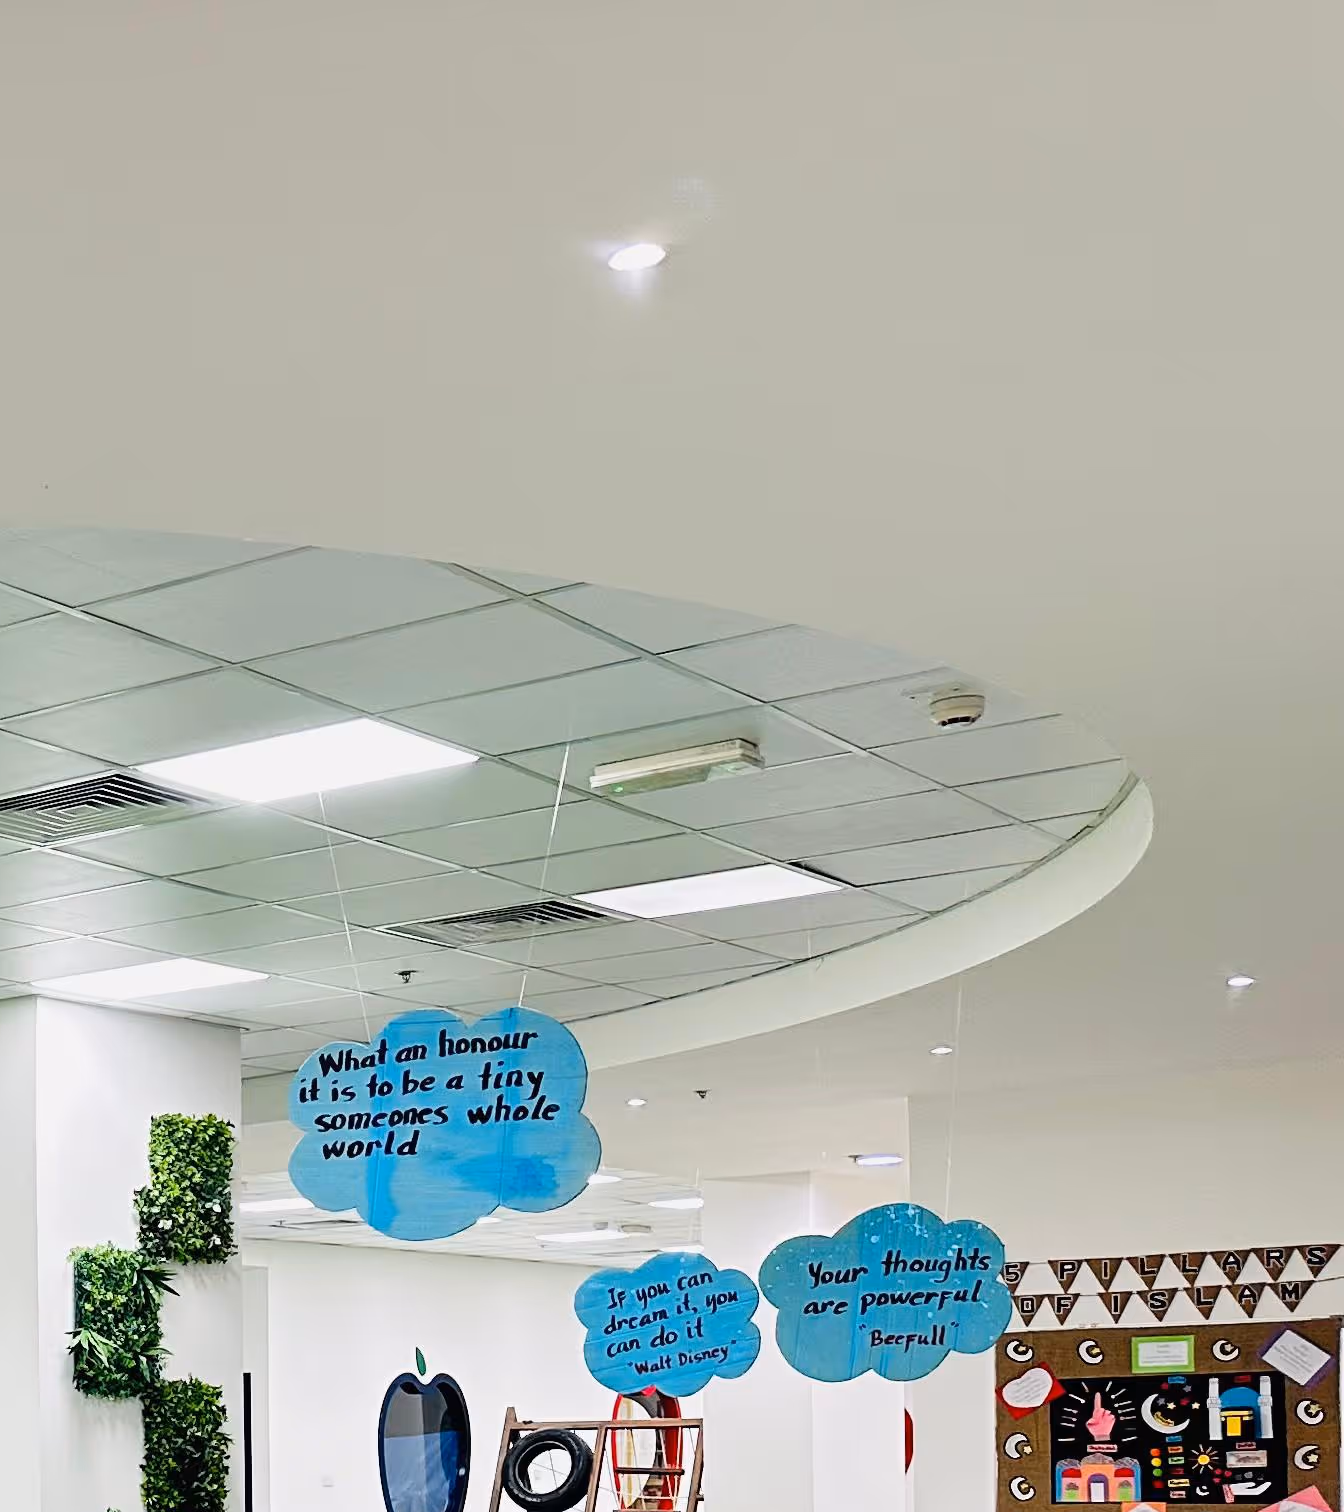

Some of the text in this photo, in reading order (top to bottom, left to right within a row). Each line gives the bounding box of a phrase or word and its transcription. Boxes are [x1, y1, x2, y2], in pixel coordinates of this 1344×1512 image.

[318, 1028, 538, 1078] What an honour
[299, 1061, 545, 1103] it is to be a tiny
[314, 1093, 561, 1133] someones whole
[322, 1130, 420, 1160] world
[808, 1247, 992, 1289] Your thoughts
[1004, 1246, 1327, 1284] 5 PILLARS
[607, 1272, 714, 1310] If you can
[802, 1279, 983, 1316] are powerful
[1020, 1281, 1303, 1316] OF ISLAM
[603, 1307, 669, 1336] dream
[705, 1290, 739, 1314] you
[606, 1316, 704, 1359] can do it
